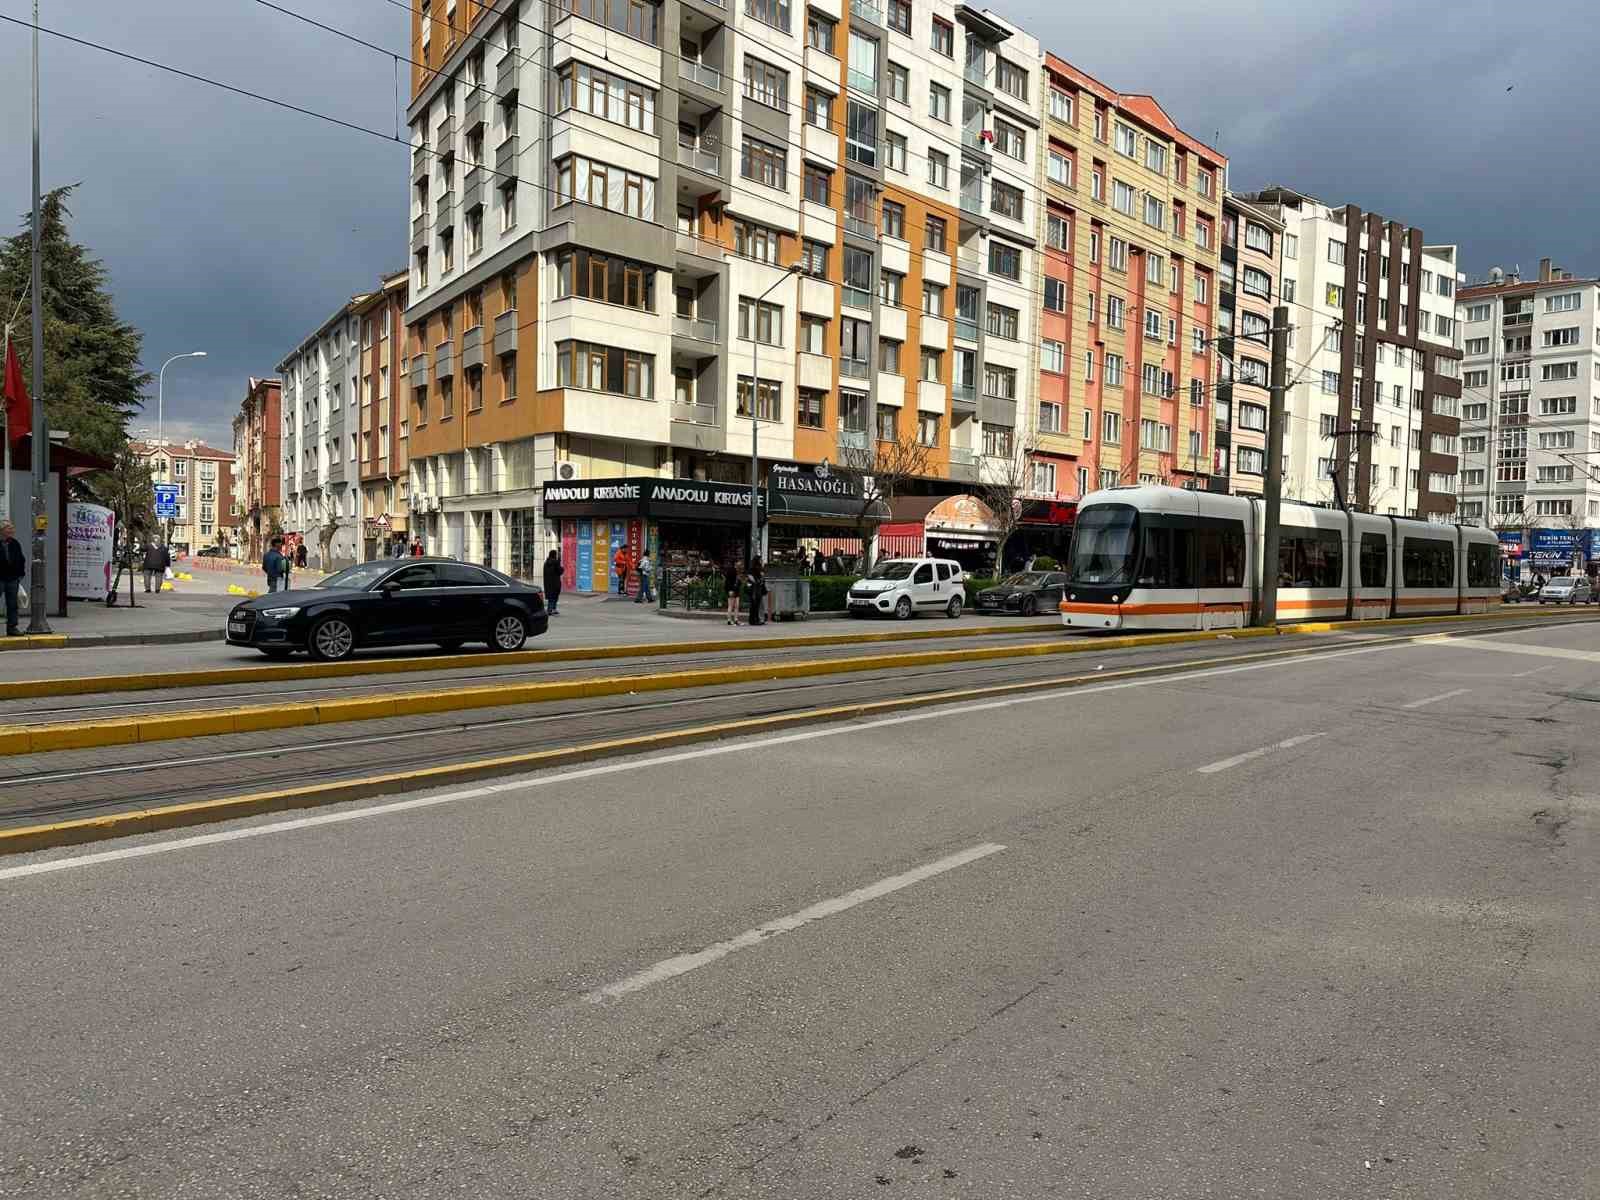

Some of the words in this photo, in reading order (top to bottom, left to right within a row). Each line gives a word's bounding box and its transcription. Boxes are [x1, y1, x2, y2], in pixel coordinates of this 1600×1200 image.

[163, 493, 171, 502] P
[544, 487, 590, 501] ANADOLU
[593, 483, 641, 500] KIRTASİYE
[651, 485, 708, 502] ANADOLU
[714, 491, 764, 506] KIRTASİE
